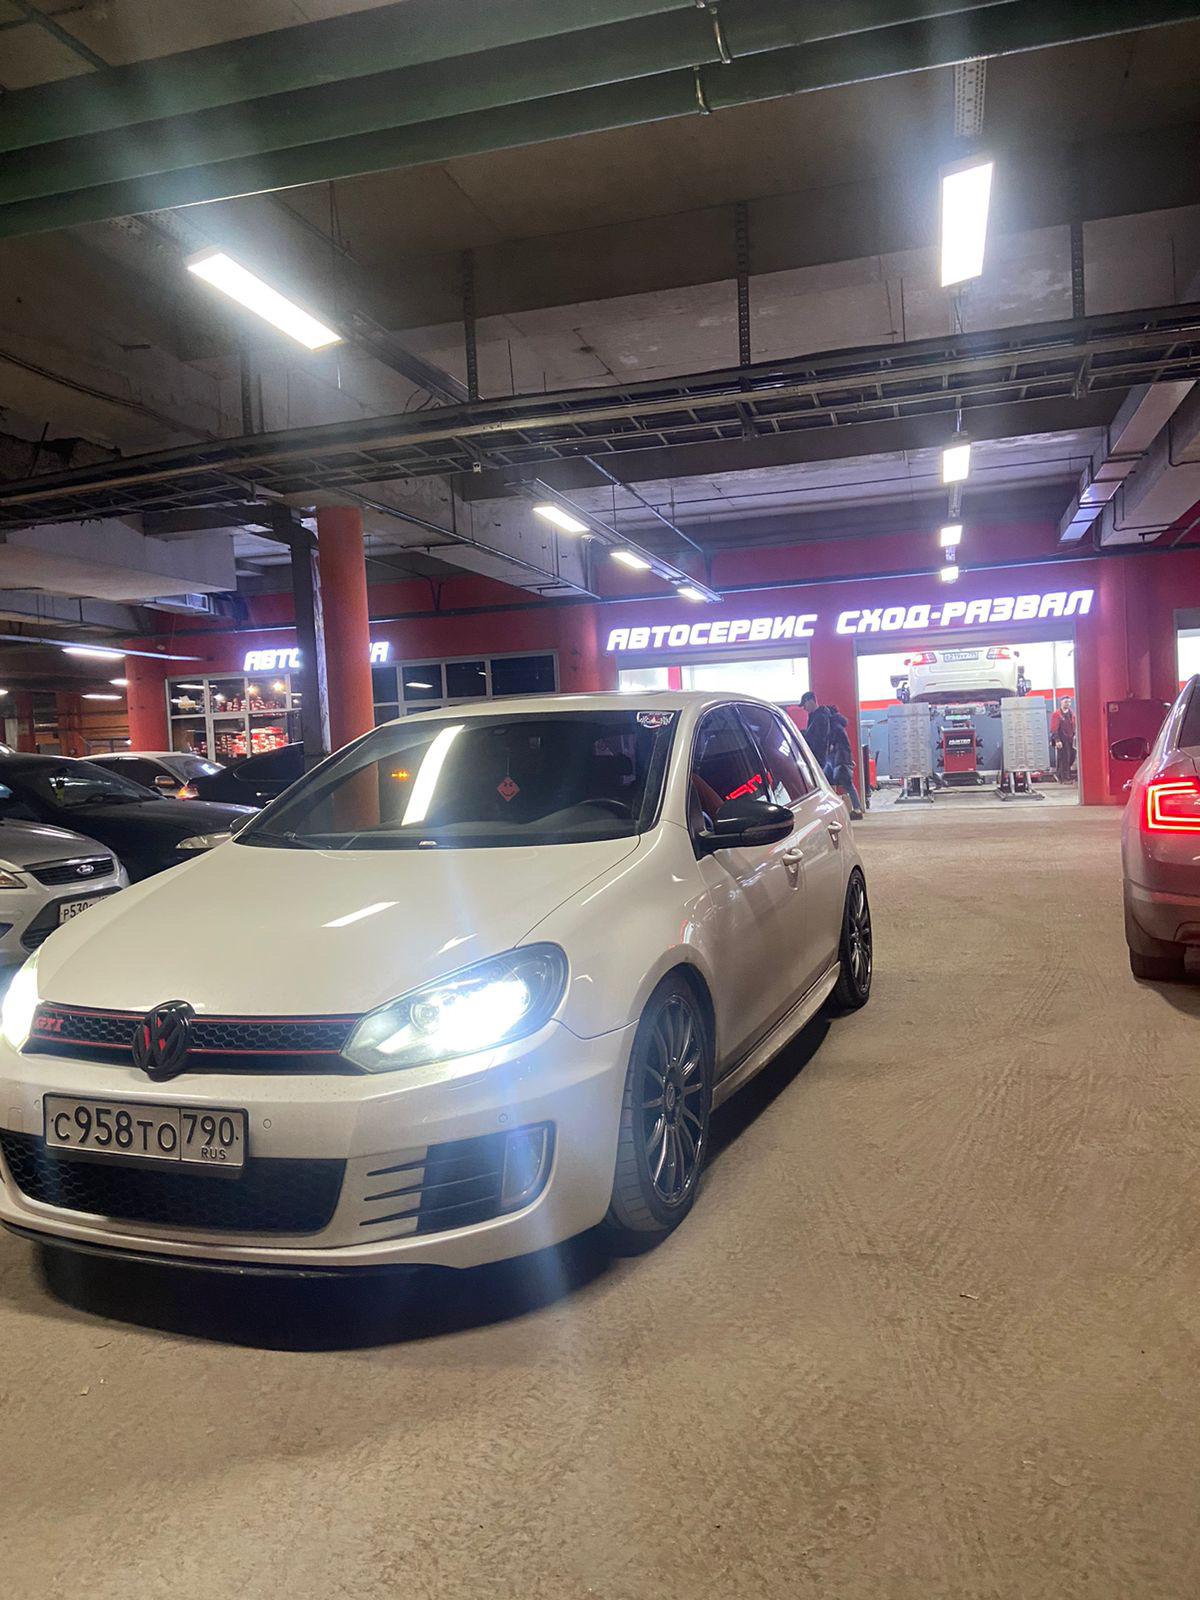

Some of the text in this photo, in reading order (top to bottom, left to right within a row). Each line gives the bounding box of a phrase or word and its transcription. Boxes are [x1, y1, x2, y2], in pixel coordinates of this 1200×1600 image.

[836, 589, 1094, 634] СХОД-РАЗВАЛ
[606, 614, 818, 651] АВТОСЕРВИС
[54, 1105, 235, 1152] С958ТО 790
[201, 1146, 227, 1160] RUS
